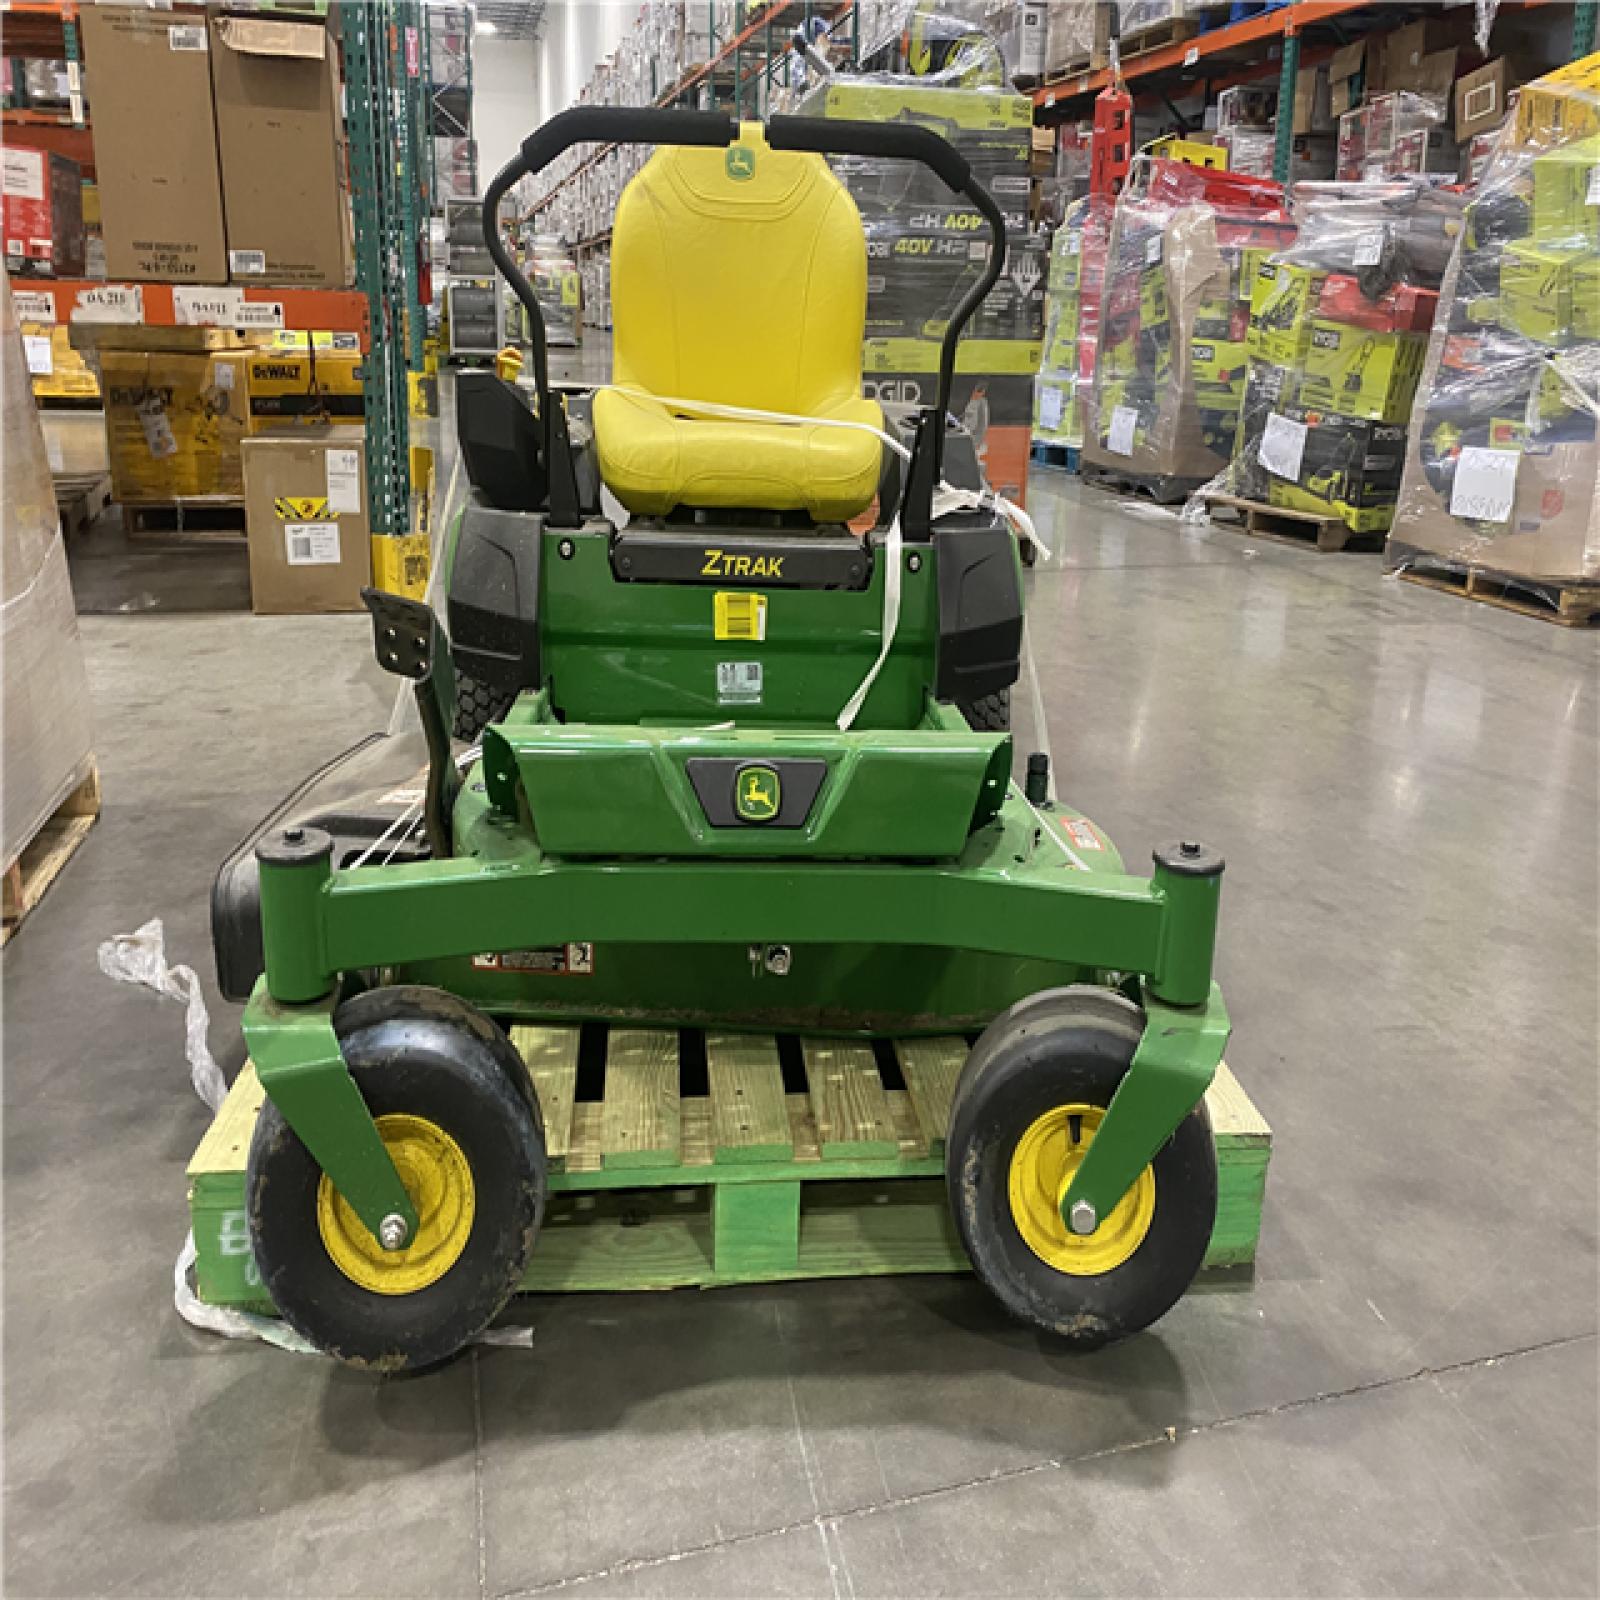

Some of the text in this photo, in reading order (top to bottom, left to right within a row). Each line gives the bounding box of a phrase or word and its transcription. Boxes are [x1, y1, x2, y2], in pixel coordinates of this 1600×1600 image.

[895, 238, 933, 254] 40V
[862, 379, 921, 403] DGID
[701, 549, 785, 578] ZTRAK
